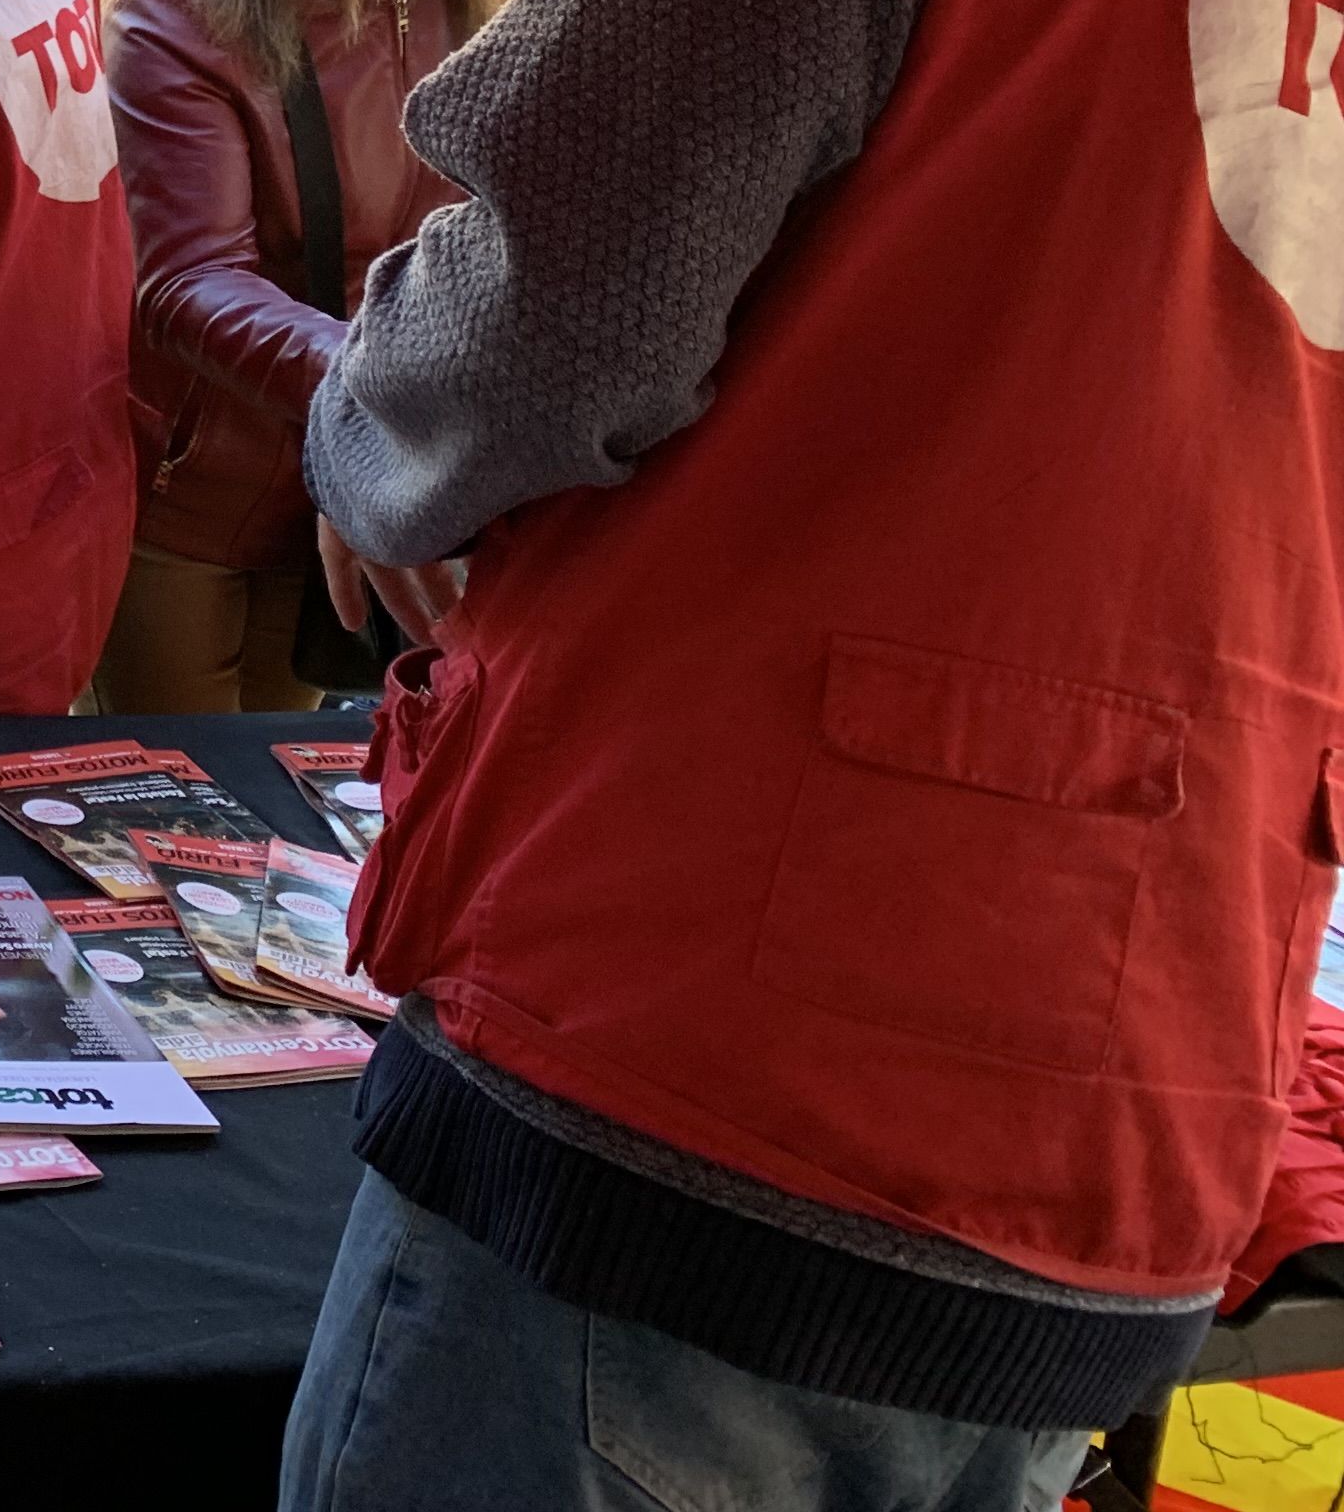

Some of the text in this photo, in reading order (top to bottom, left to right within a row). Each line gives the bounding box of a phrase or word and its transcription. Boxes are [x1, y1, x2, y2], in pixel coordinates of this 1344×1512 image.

[64, 753, 148, 775] MOTOS
[157, 848, 239, 869] FURIÓ
[122, 908, 177, 922] TOS
[178, 1037, 318, 1062] Cerdanyola
[19, 1145, 78, 1166] TOT
